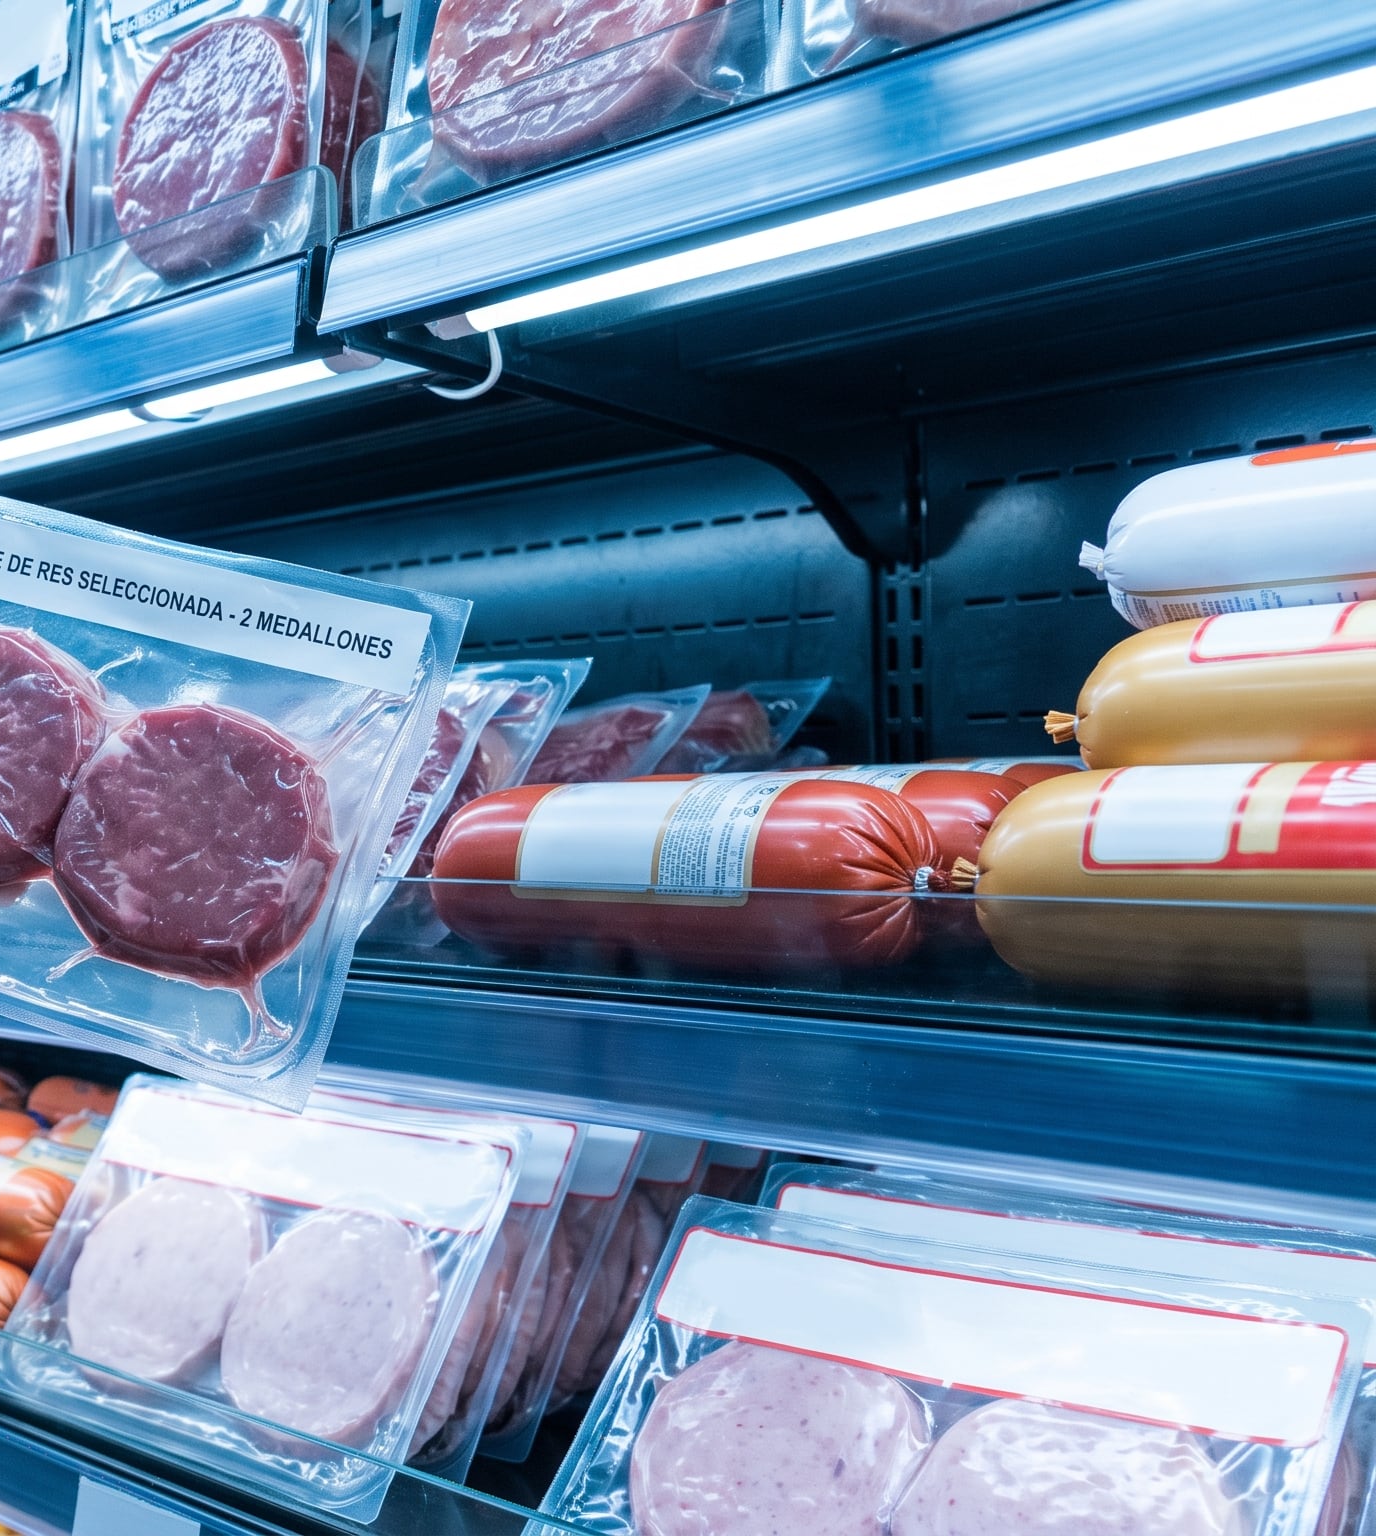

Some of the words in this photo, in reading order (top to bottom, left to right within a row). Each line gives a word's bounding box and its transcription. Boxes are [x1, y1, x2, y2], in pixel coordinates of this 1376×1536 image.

[7, 553, 34, 577] DE
[36, 560, 74, 586] RES
[77, 570, 223, 622] SELECCIONADA
[239, 607, 253, 628] 2
[255, 610, 393, 659] MEDALLONES
